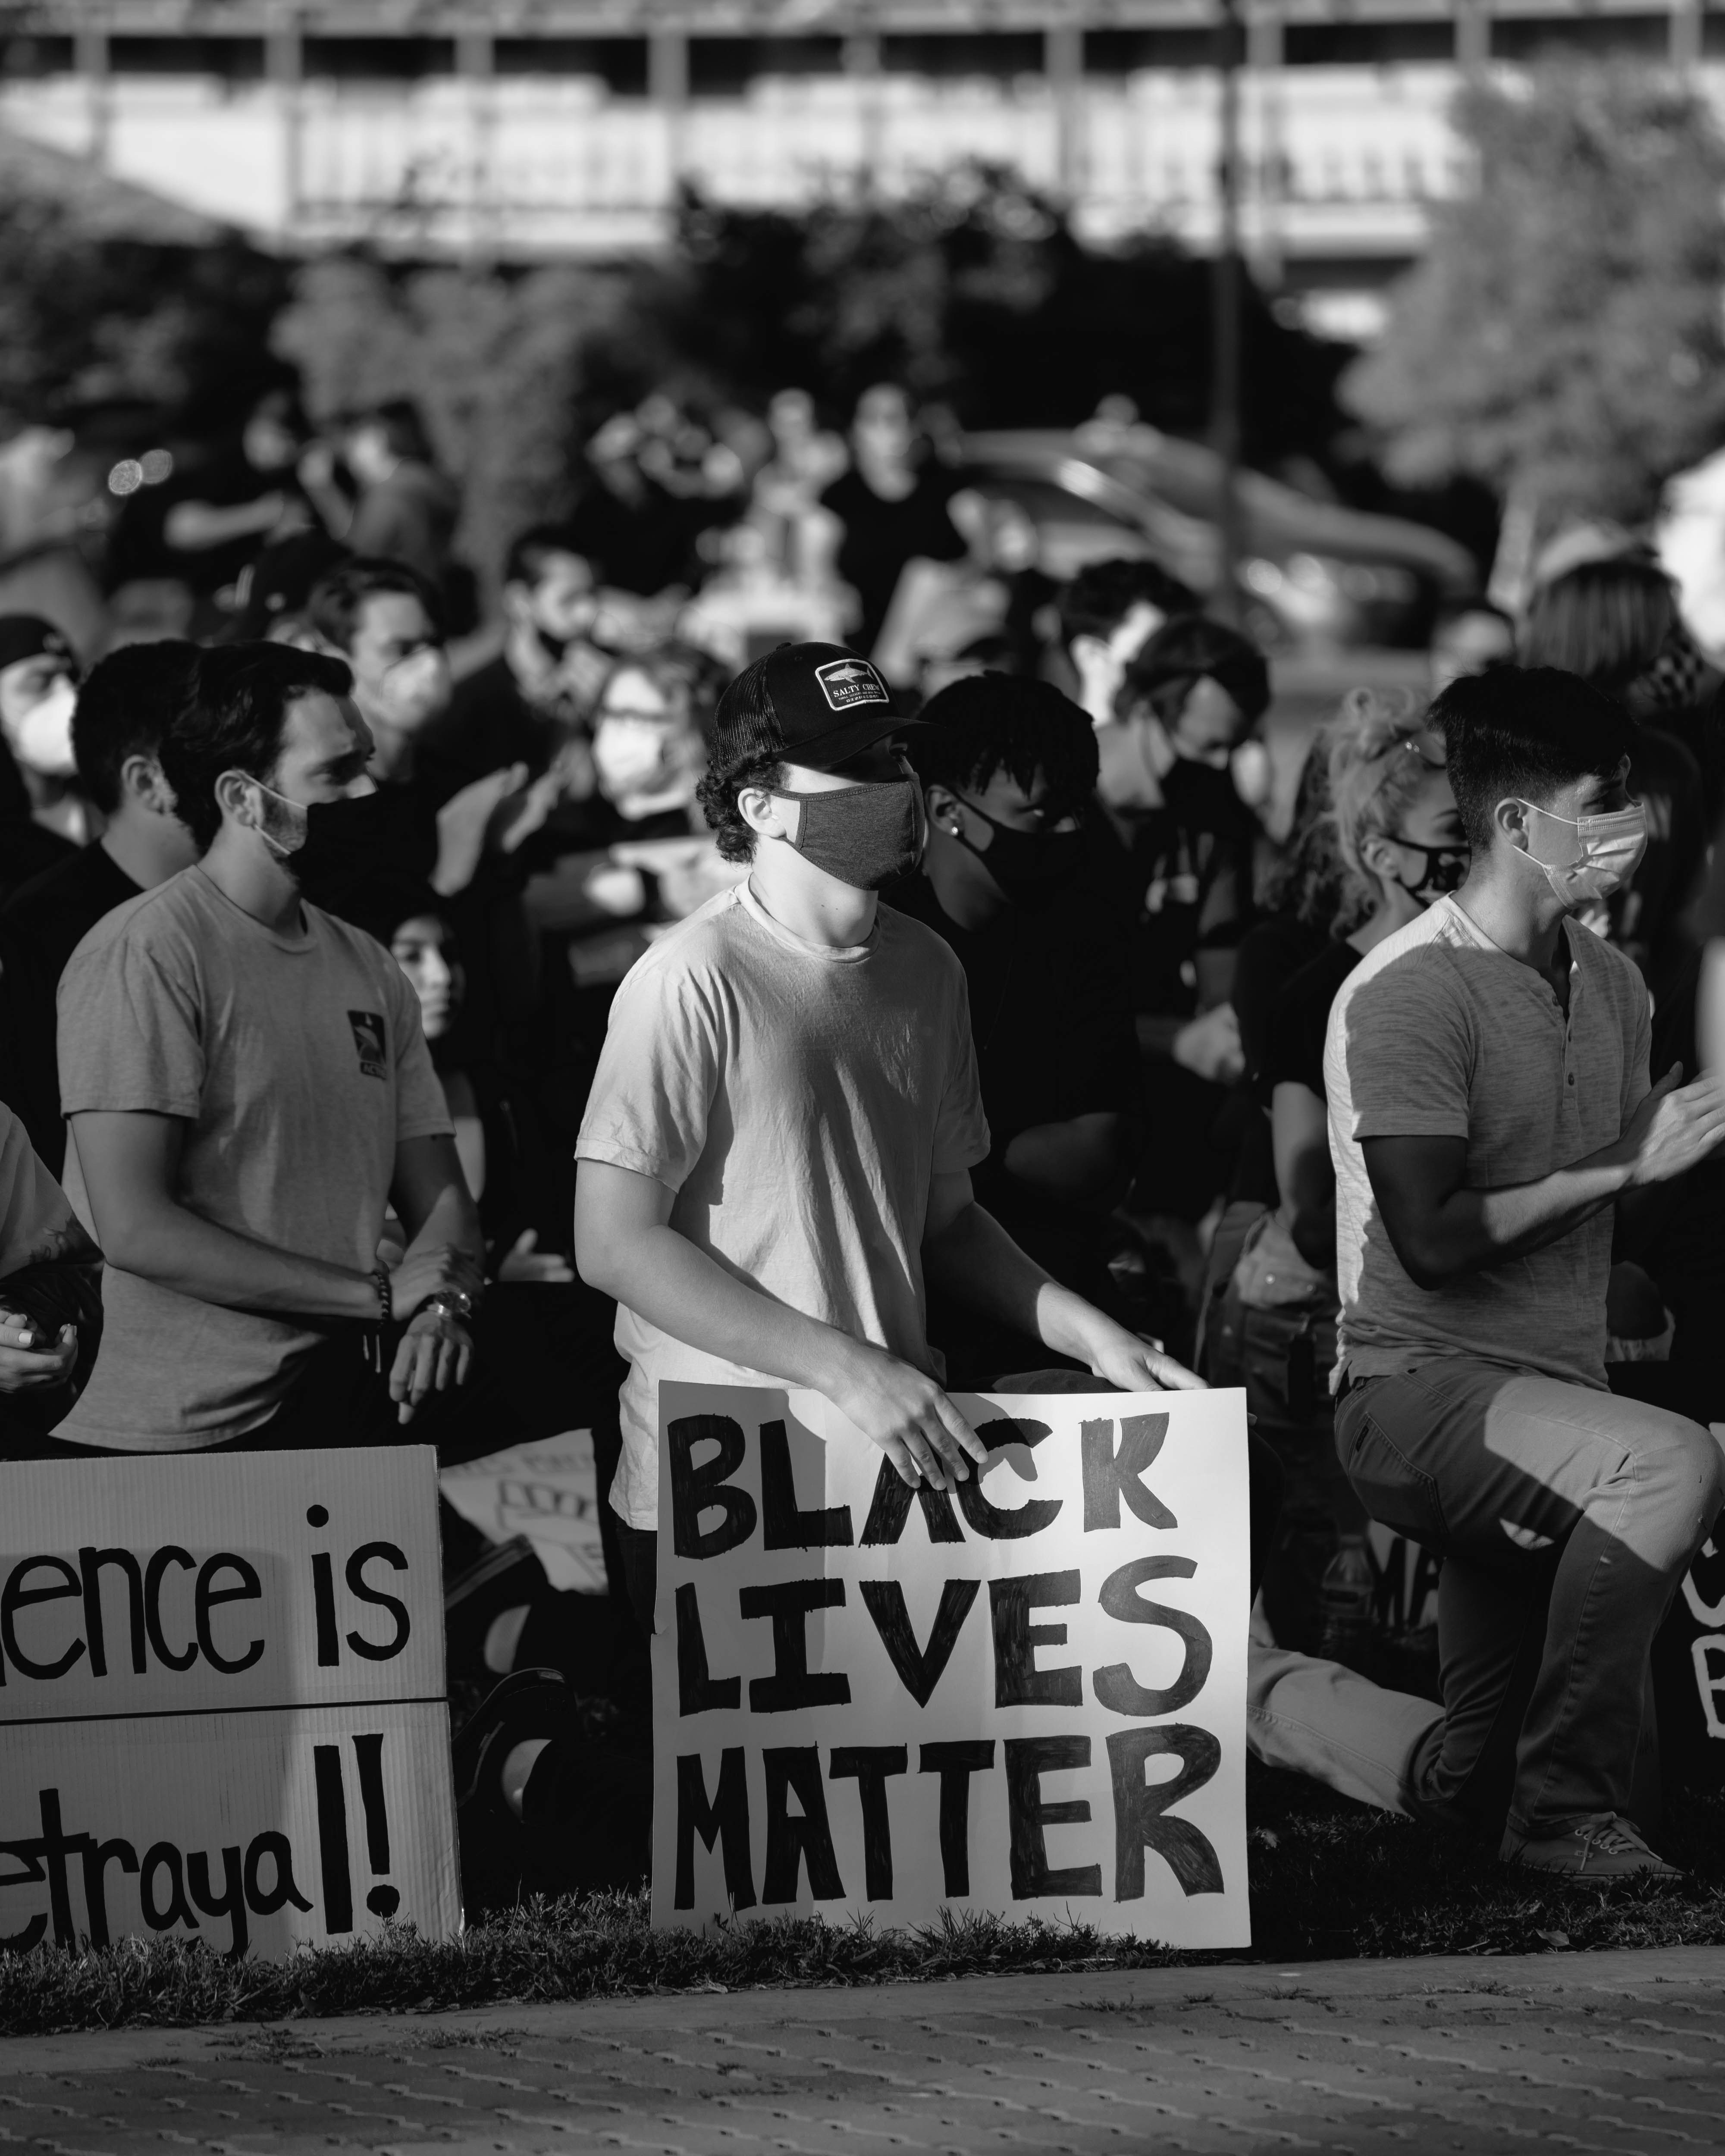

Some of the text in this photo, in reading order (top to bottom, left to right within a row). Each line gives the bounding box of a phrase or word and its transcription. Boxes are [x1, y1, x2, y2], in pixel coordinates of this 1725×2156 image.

[833, 684, 859, 697] SALTY
[667, 1412, 1178, 1560] BLACK
[0, 1504, 410, 1686] ence is
[674, 1555, 1213, 1717] LIVES
[674, 1723, 1224, 1910] MATTER
